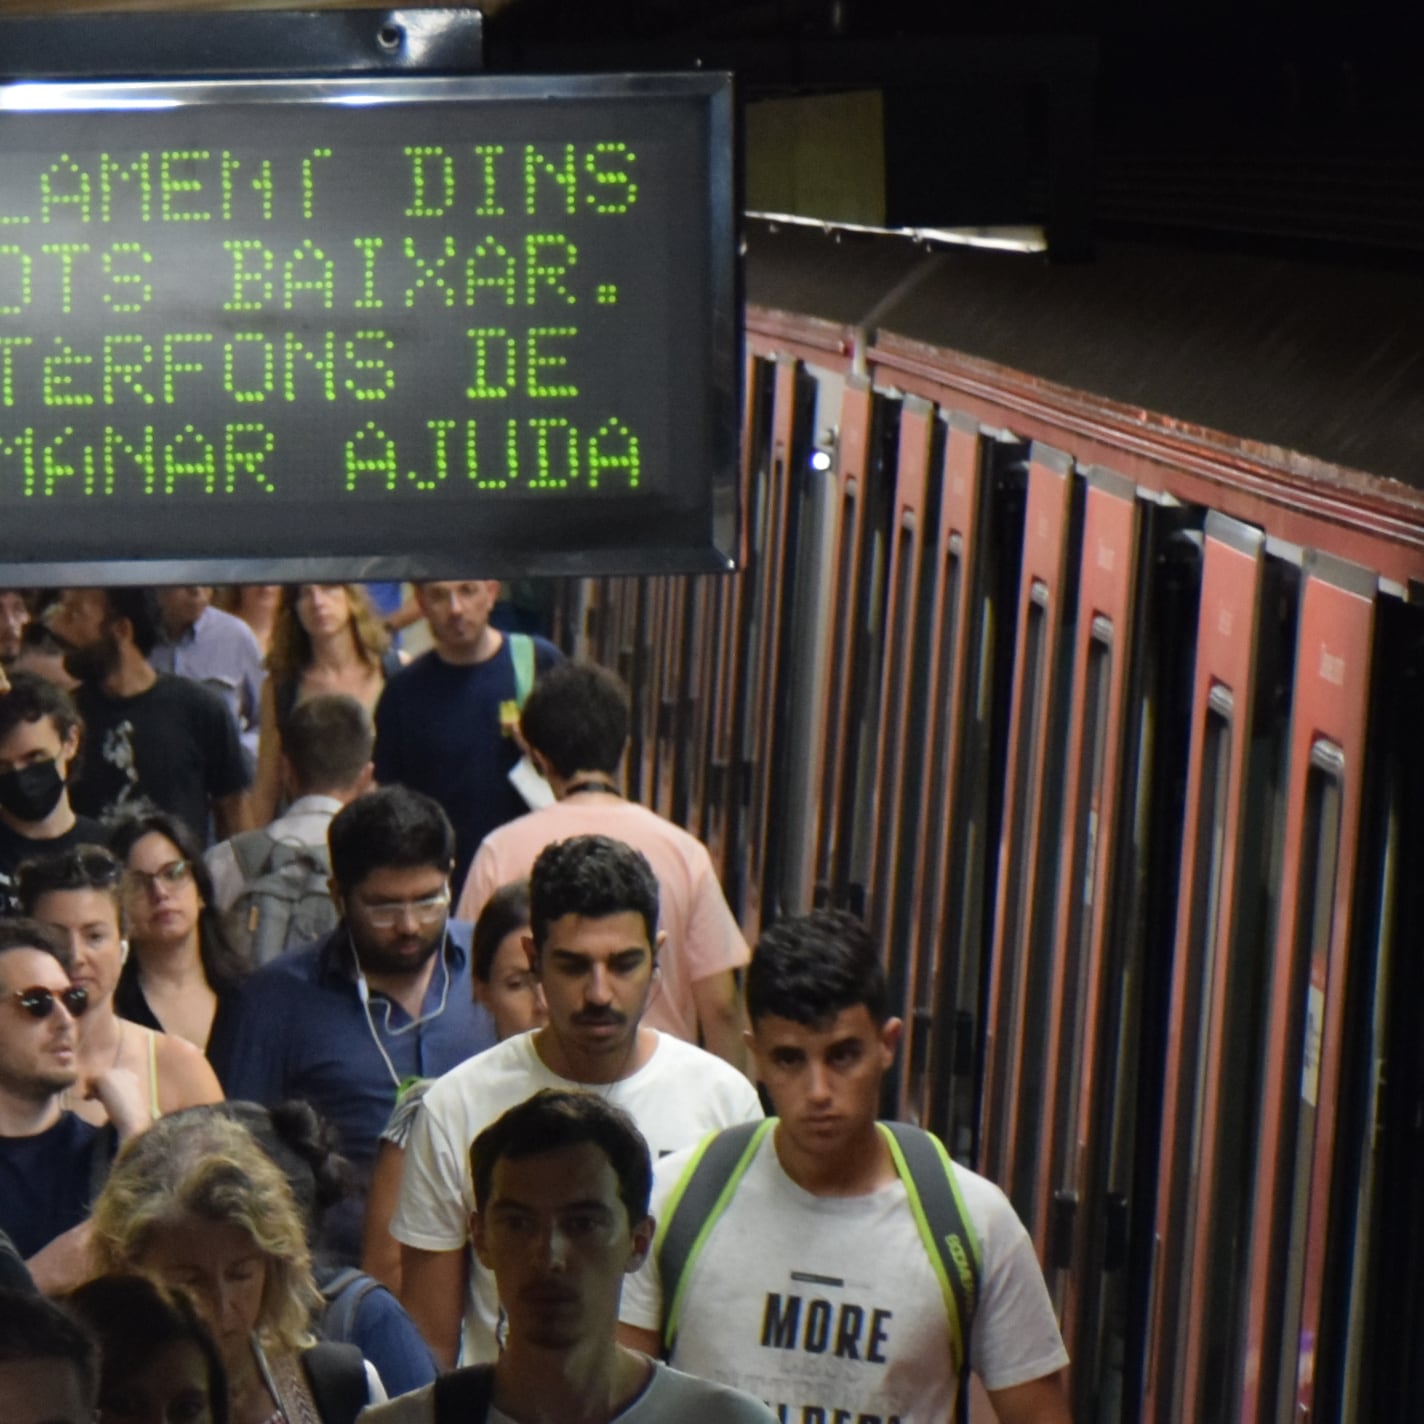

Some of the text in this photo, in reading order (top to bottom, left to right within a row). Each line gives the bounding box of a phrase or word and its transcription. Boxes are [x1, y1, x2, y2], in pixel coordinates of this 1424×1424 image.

[403, 141, 639, 218] DINS
[222, 232, 619, 312] BAIXAR.
[465, 326, 580, 401] DE
[344, 416, 642, 492] AJUDA
[760, 1291, 893, 1365] MORE
